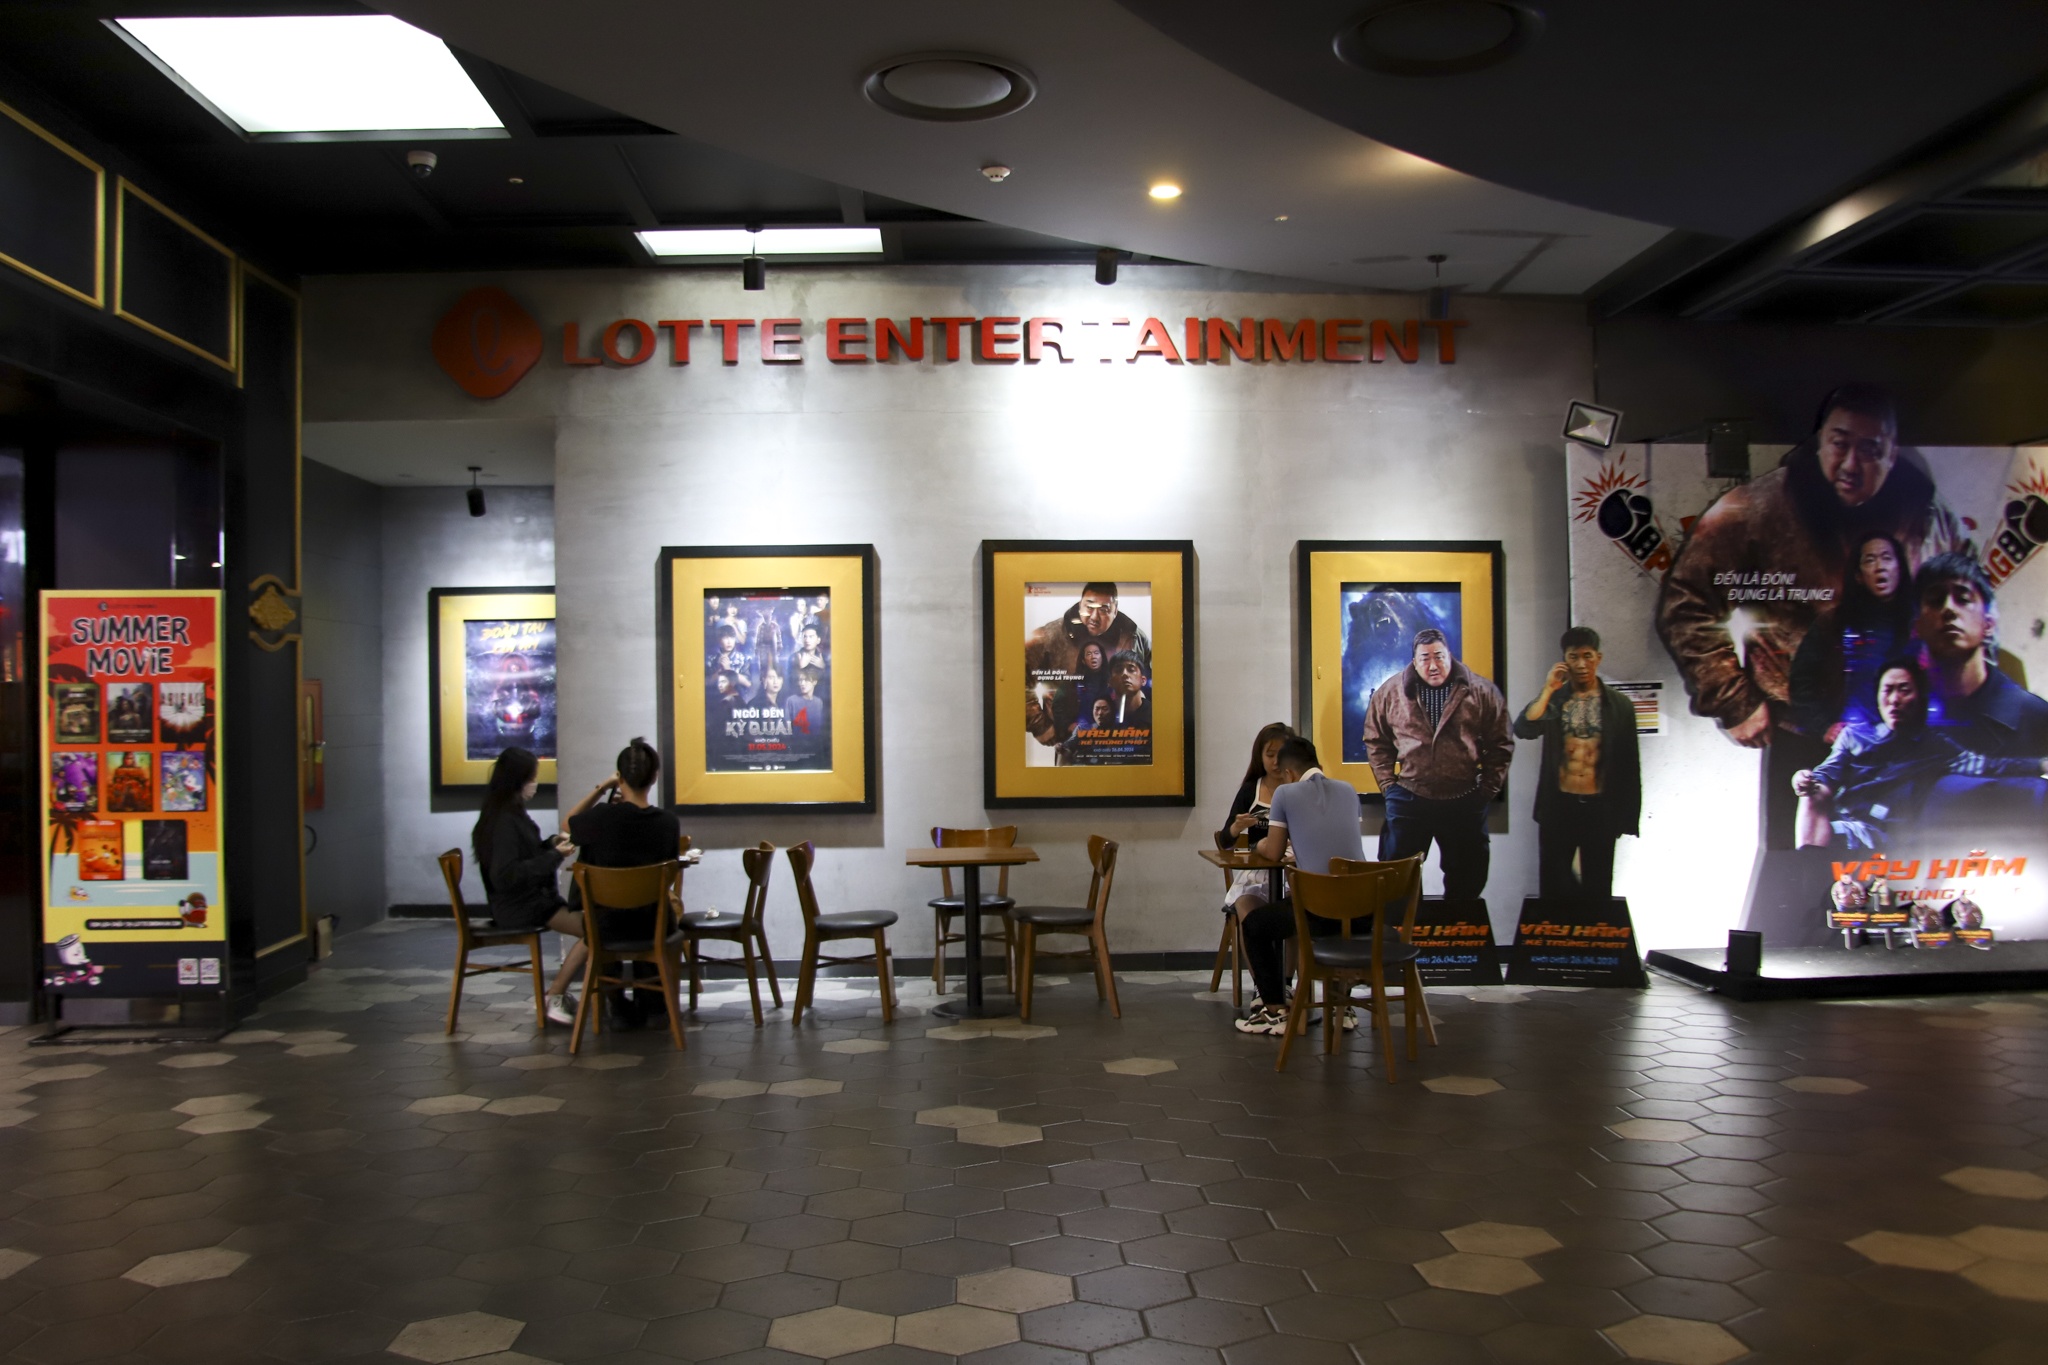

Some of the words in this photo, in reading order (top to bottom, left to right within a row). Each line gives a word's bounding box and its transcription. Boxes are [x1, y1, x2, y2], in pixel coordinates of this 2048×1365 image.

[562, 317, 803, 367] LOTTE
[72, 614, 191, 646] SUMMER
[733, 707, 760, 719] NGÔI
[793, 706, 811, 735] 4
[1077, 727, 1110, 738] VÂY
[1112, 726, 1150, 738] HÃM
[1831, 853, 1920, 882] VÂY
[1927, 848, 2027, 880] HÃM
[1433, 921, 1489, 937] HÃM
[1520, 920, 1571, 936] VÂY
[1572, 922, 1631, 938] HÃM
[1431, 955, 1478, 964] 26.04.2024
